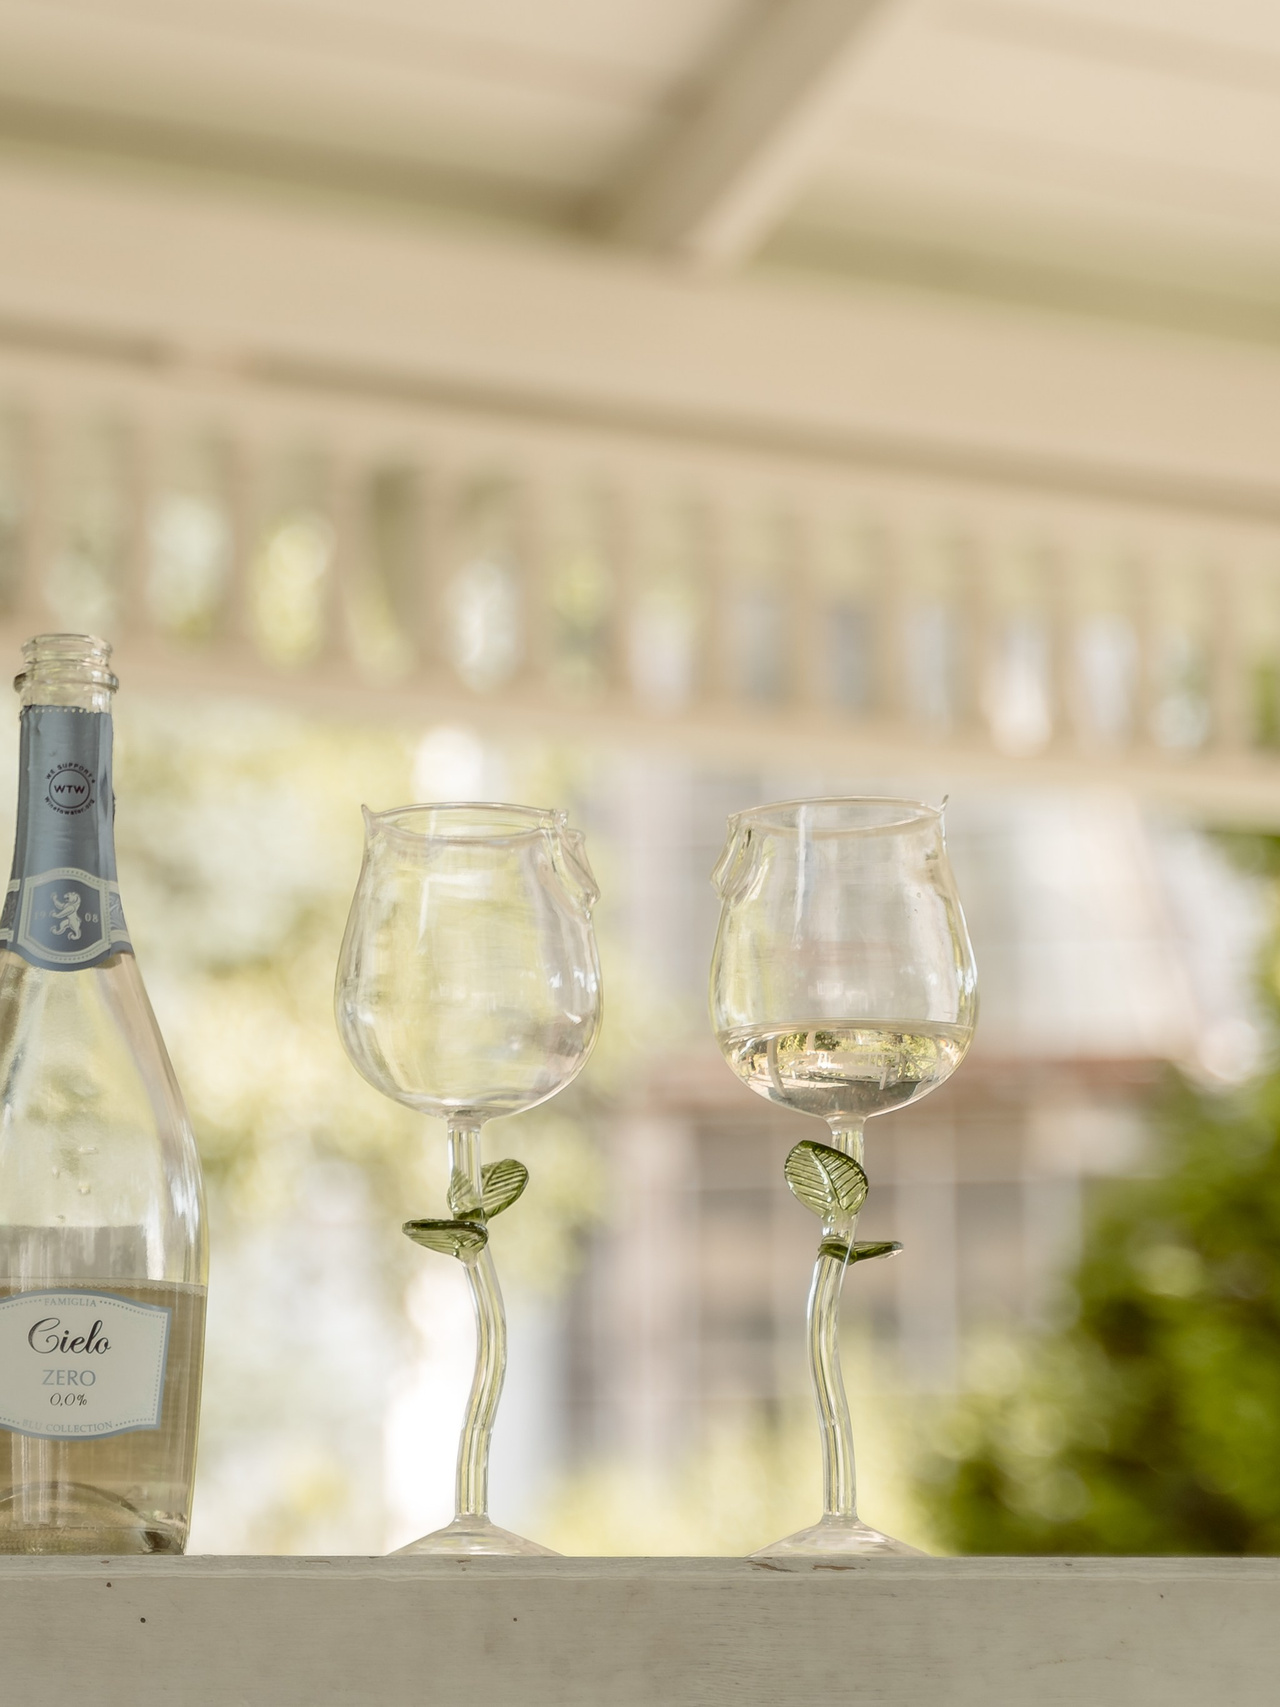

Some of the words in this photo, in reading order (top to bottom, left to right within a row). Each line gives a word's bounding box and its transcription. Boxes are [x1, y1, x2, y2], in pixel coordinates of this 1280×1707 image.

[45, 769, 56, 780] WE
[57, 762, 93, 778] SUPPORT
[54, 785, 86, 794] WTW
[84, 912, 99, 923] 08
[44, 1297, 97, 1308] FAMIGLIA
[27, 1317, 112, 1355] Cielo
[41, 1369, 97, 1387] ZERO
[49, 1392, 88, 1407] 0,0%
[22, 1418, 44, 1431] BLU
[45, 1420, 113, 1433] COLLECTION
